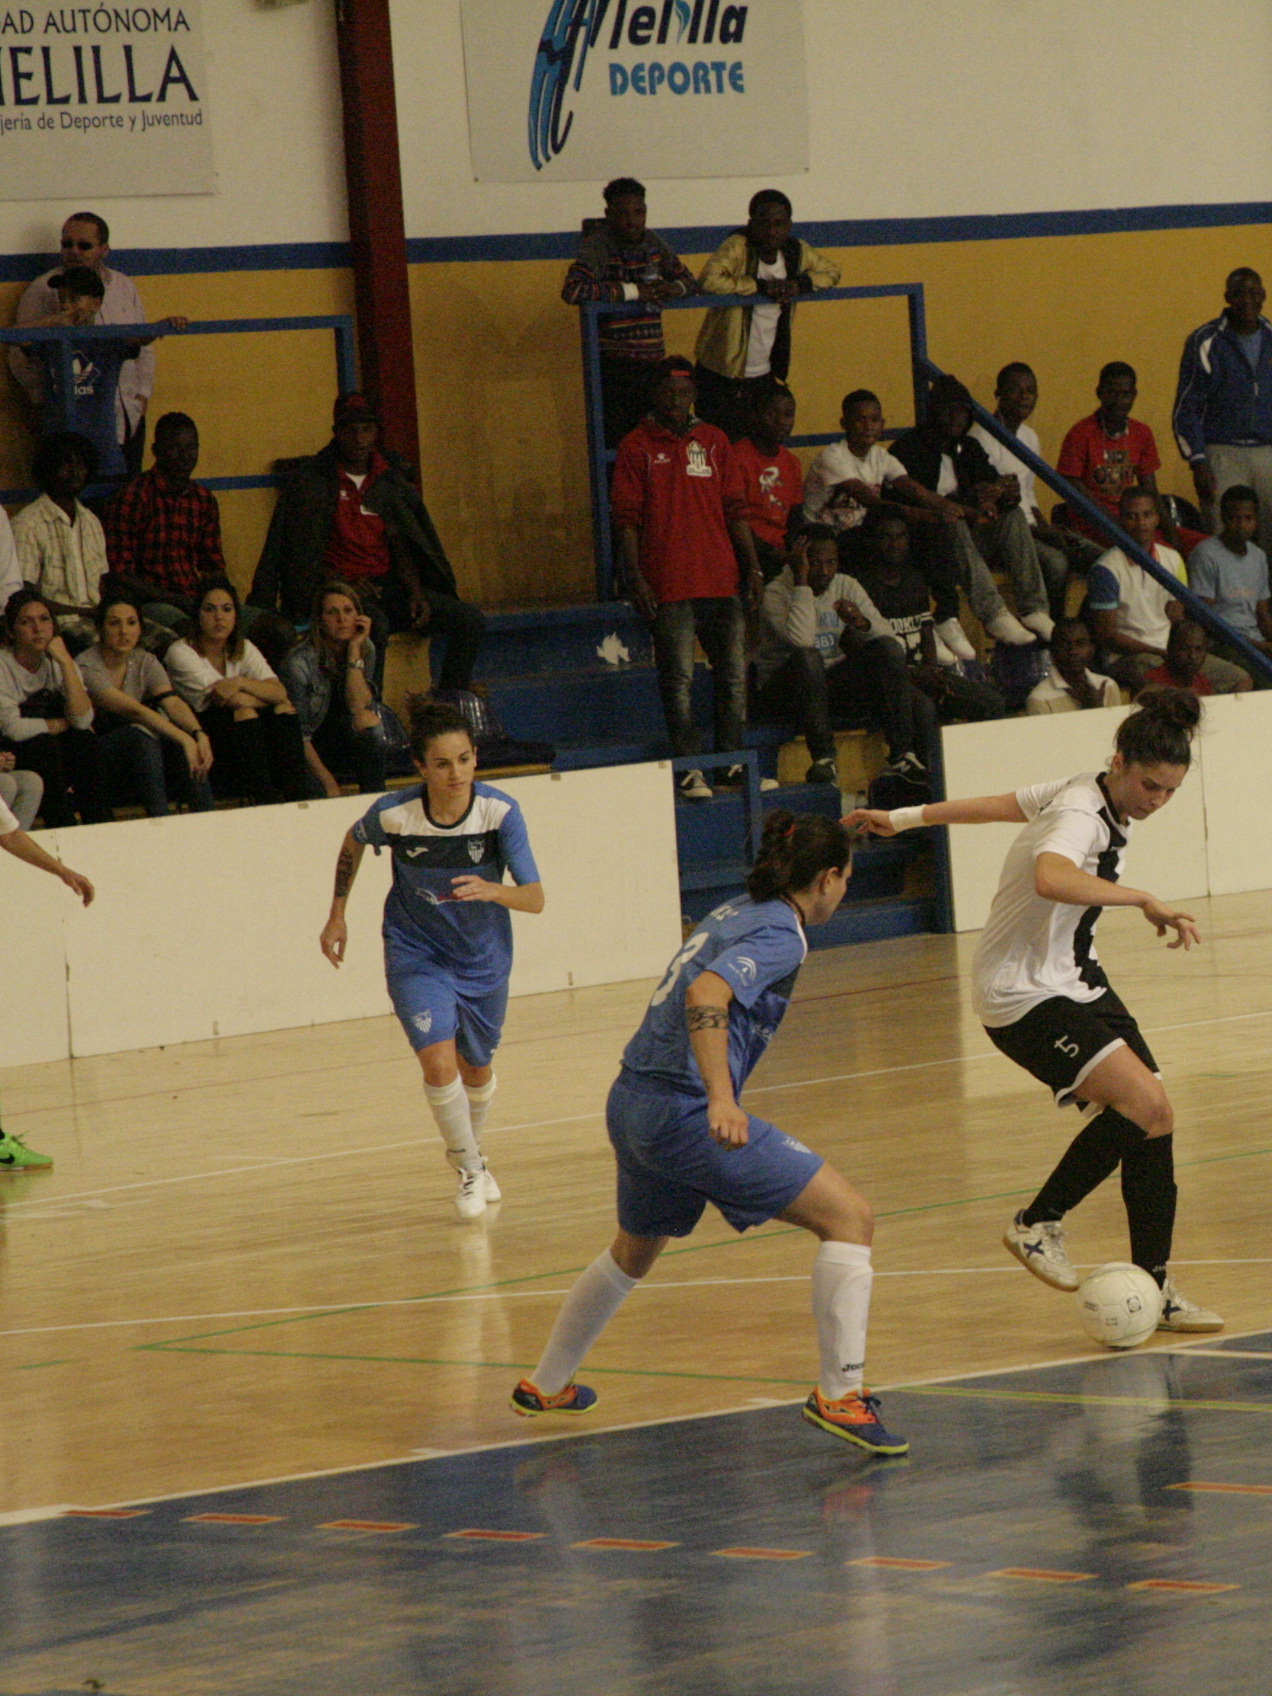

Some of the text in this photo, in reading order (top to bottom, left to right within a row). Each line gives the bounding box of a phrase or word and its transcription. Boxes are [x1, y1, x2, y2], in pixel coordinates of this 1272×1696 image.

[43, 2, 190, 34] AUTÓNOMA
[0, 44, 199, 106] ELILLA
[608, 61, 745, 96] DEPORTE
[37, 112, 55, 130] de
[60, 111, 124, 134] Deporte
[129, 113, 137, 132] y
[142, 108, 203, 132] Juventud
[1053, 1034, 1079, 1058] 5
